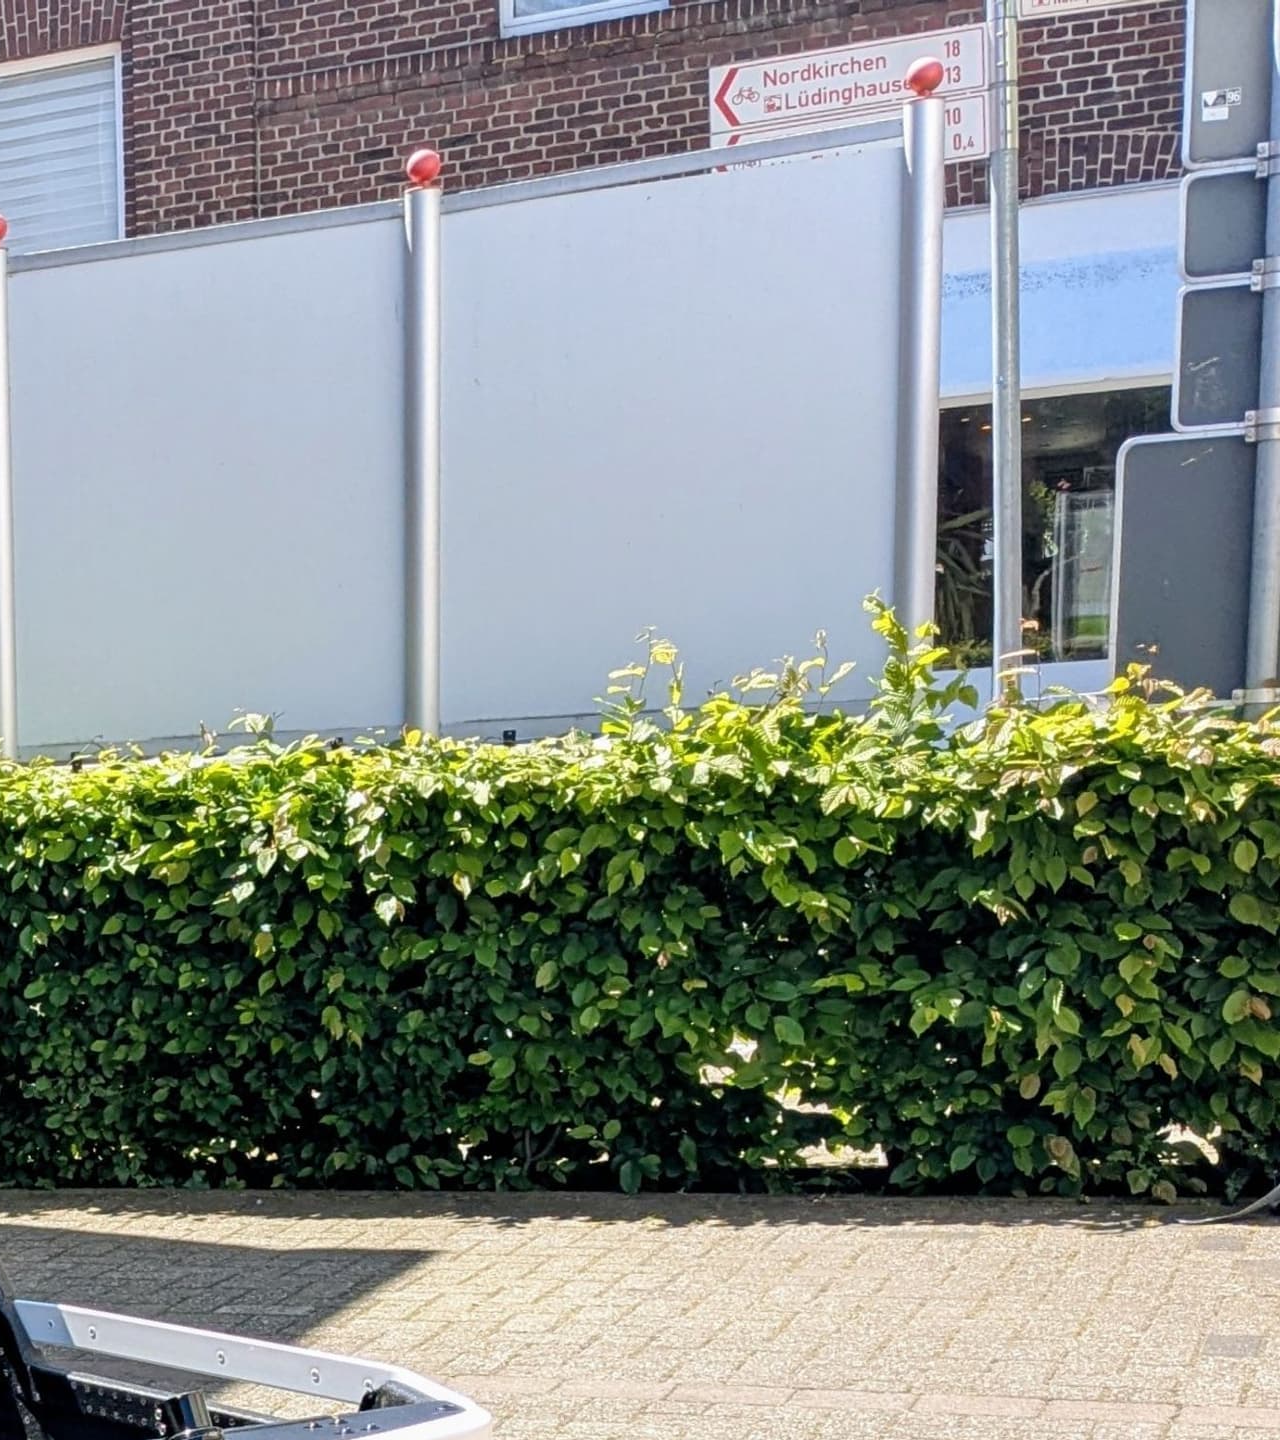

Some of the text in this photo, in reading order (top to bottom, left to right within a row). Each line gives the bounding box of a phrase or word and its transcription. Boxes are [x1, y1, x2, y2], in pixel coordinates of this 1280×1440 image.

[763, 40, 961, 88] Nordkirchen 18
[785, 66, 961, 110] Lüdinghause 13
[945, 108, 961, 126] 10
[953, 133, 975, 151] 0,4
